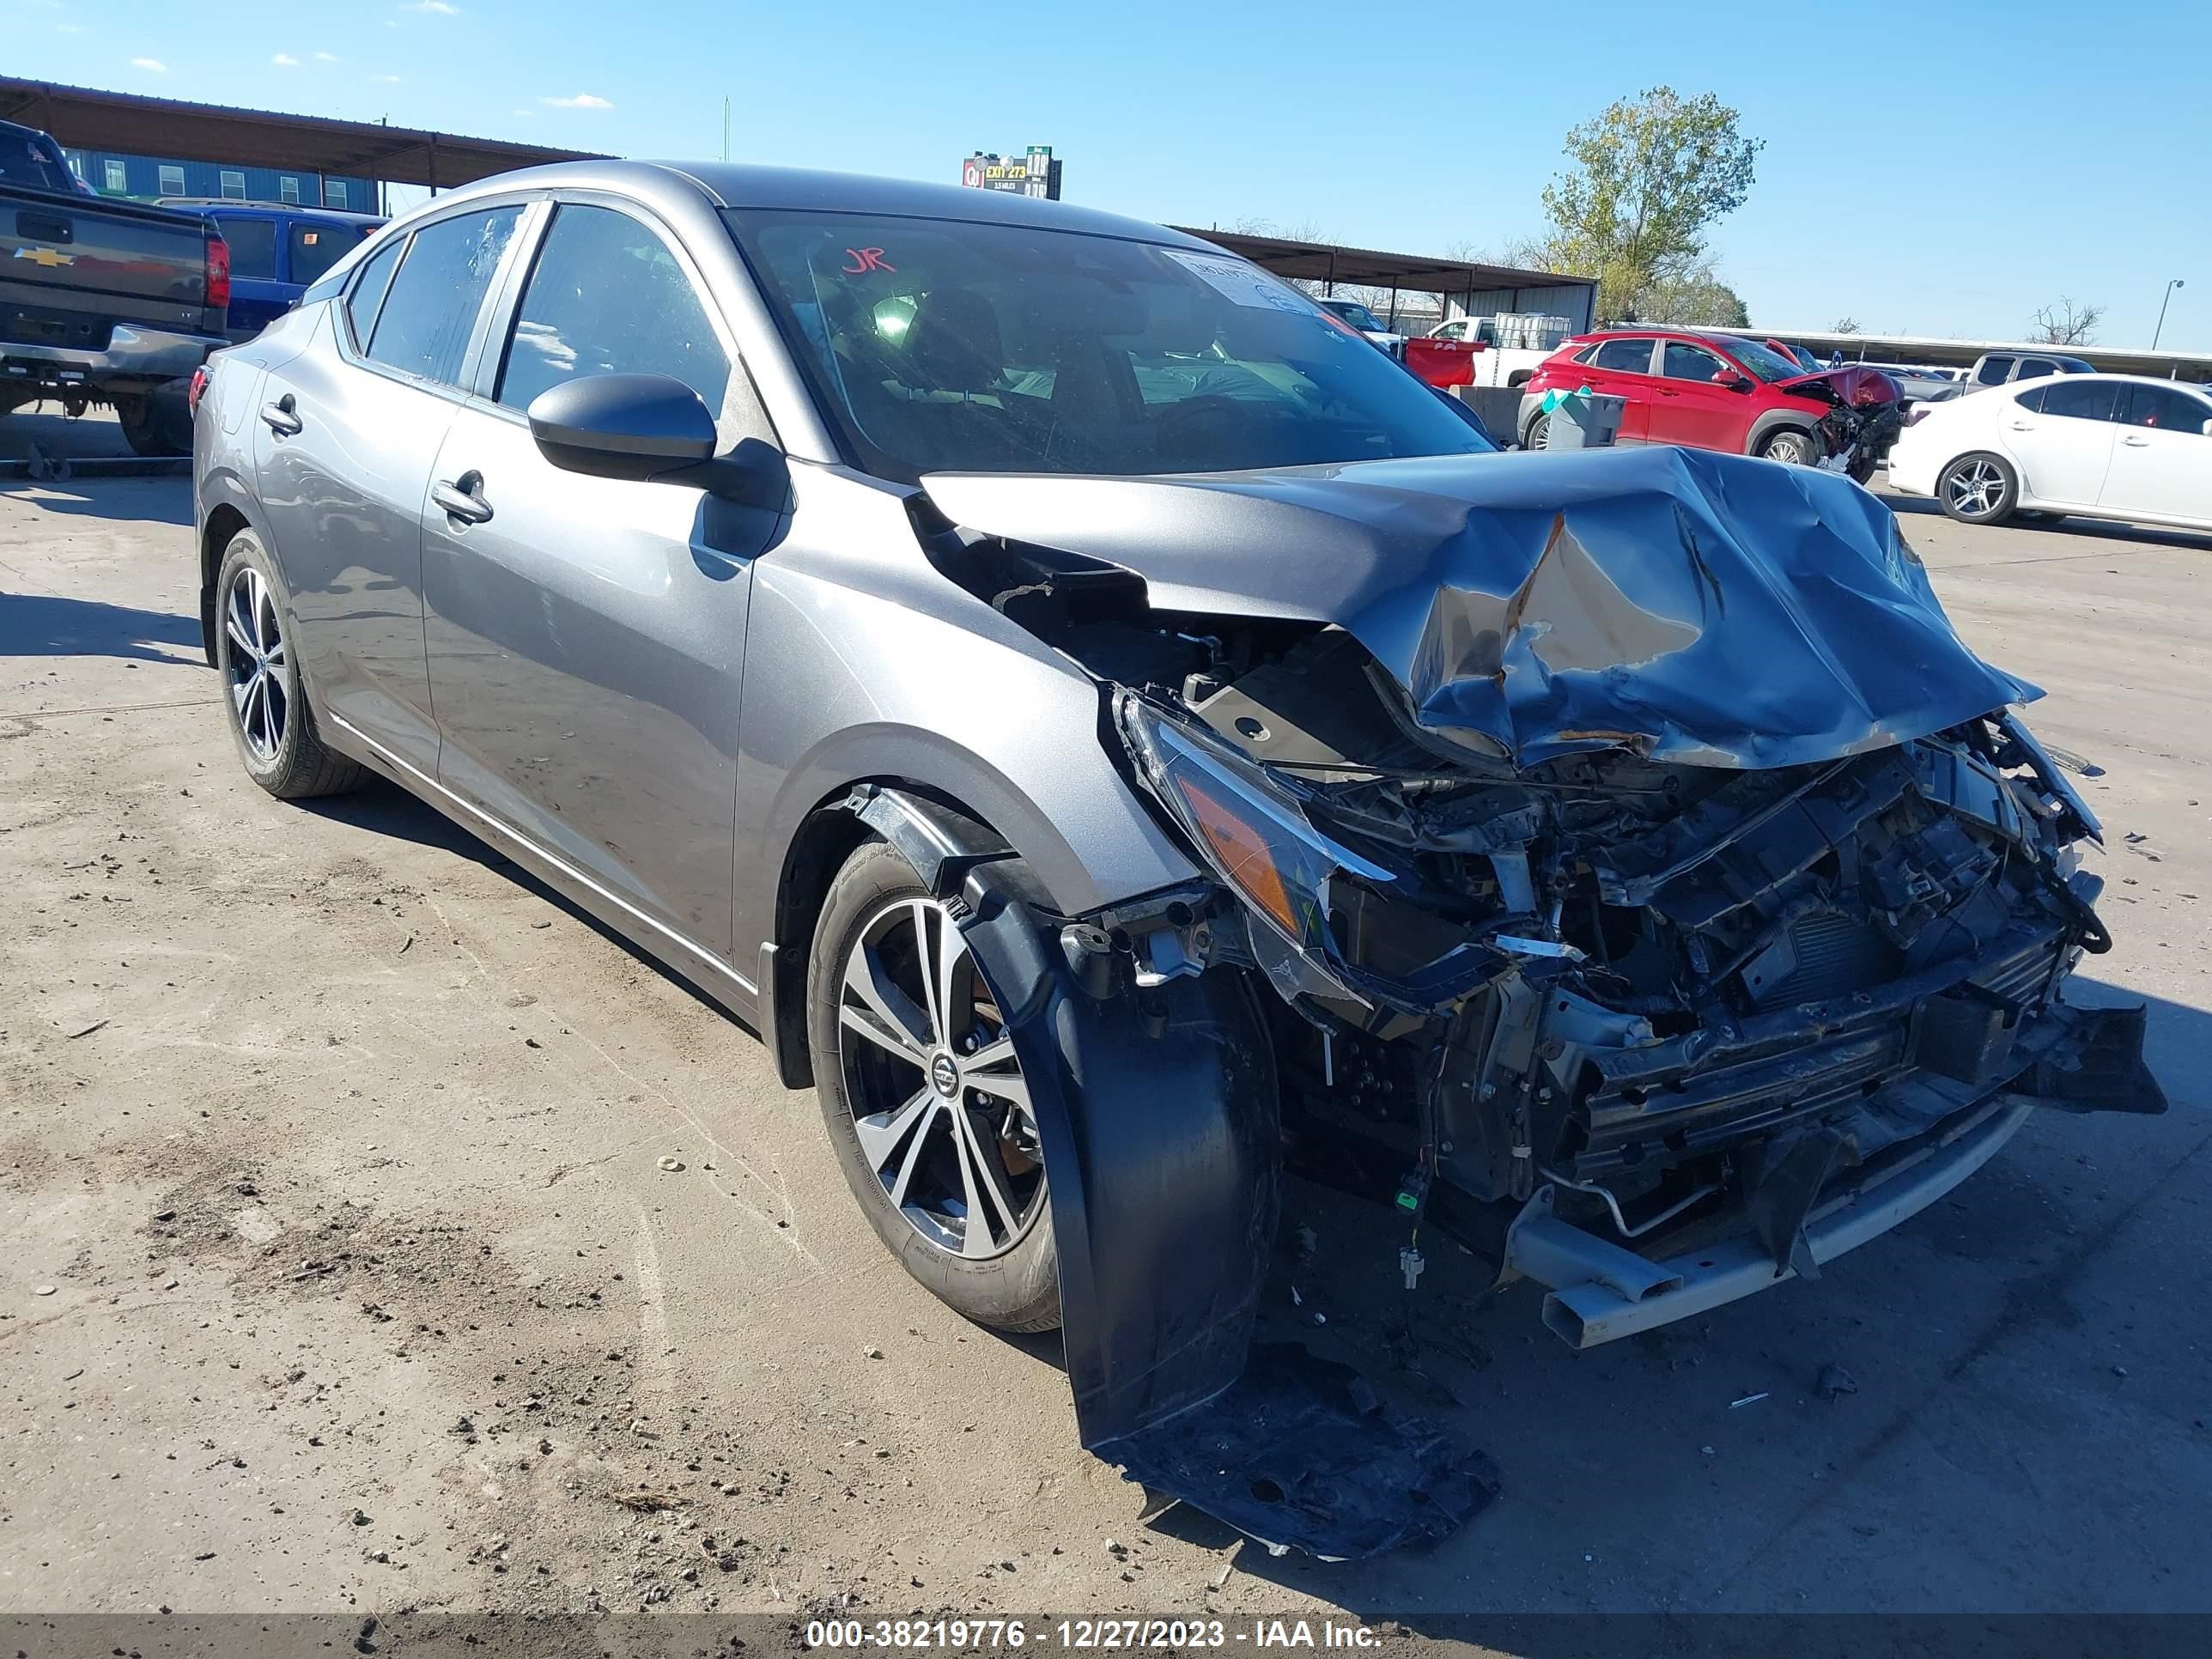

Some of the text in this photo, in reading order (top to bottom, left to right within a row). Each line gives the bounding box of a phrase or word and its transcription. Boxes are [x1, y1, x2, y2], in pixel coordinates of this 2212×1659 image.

[986, 166, 1026, 179] EXIT 273
[842, 247, 896, 275] JR
